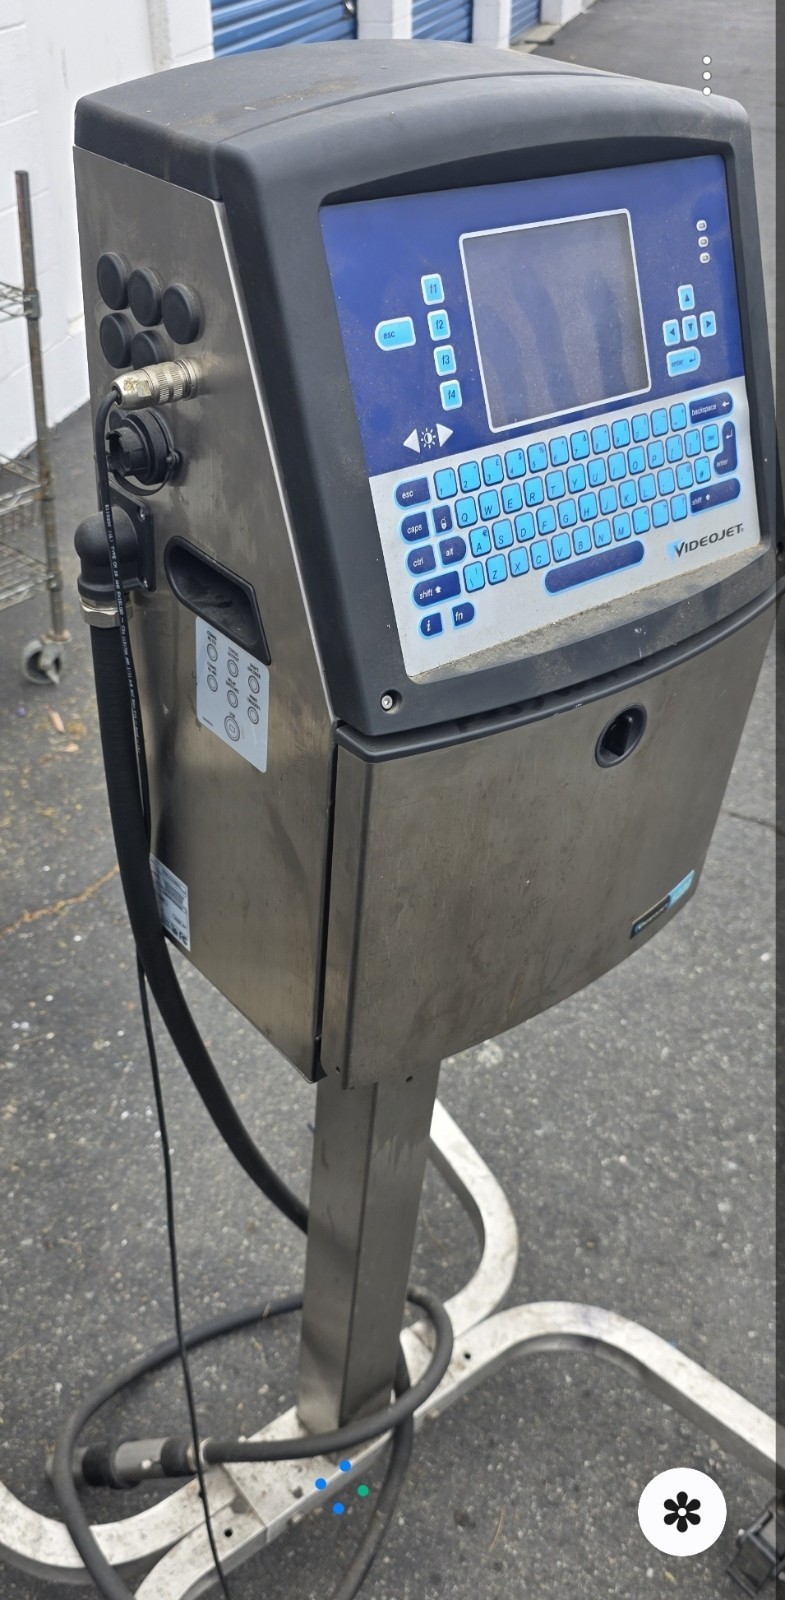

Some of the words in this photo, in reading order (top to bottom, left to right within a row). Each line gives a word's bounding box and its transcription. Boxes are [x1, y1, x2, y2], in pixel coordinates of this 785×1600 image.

[430, 283, 438, 294] f1
[436, 319, 444, 330] f2
[383, 330, 395, 339] esc
[442, 354, 450, 365] f3
[448, 390, 456, 400] f4
[692, 404, 717, 416] backspace
[402, 490, 414, 499] esc
[406, 524, 422, 534] caps
[461, 513, 468, 522] Q
[484, 505, 493, 515] W
[508, 499, 513, 508] E
[530, 493, 535, 501] R
[551, 486, 556, 495] T
[572, 480, 577, 488] Y
[592, 474, 598, 482] U
[633, 461, 638, 470] O
[476, 543, 482, 552] A
[498, 535, 504, 544] S
[521, 528, 526, 537] D
[542, 521, 547, 530] F
[563, 515, 569, 523] G
[584, 508, 589, 516] H
[624, 495, 629, 503] K
[675, 523, 743, 558] VIDEOJET
[413, 557, 424, 567] ctrl
[446, 548, 454, 556] alt
[492, 570, 498, 580] Z
[515, 562, 520, 572] X
[536, 555, 542, 564] C
[557, 548, 562, 556] V
[578, 542, 583, 550] B
[598, 534, 604, 542] N
[618, 527, 624, 536] M
[419, 589, 433, 599] shift
[426, 620, 431, 631] i
[455, 612, 463, 621] fn
